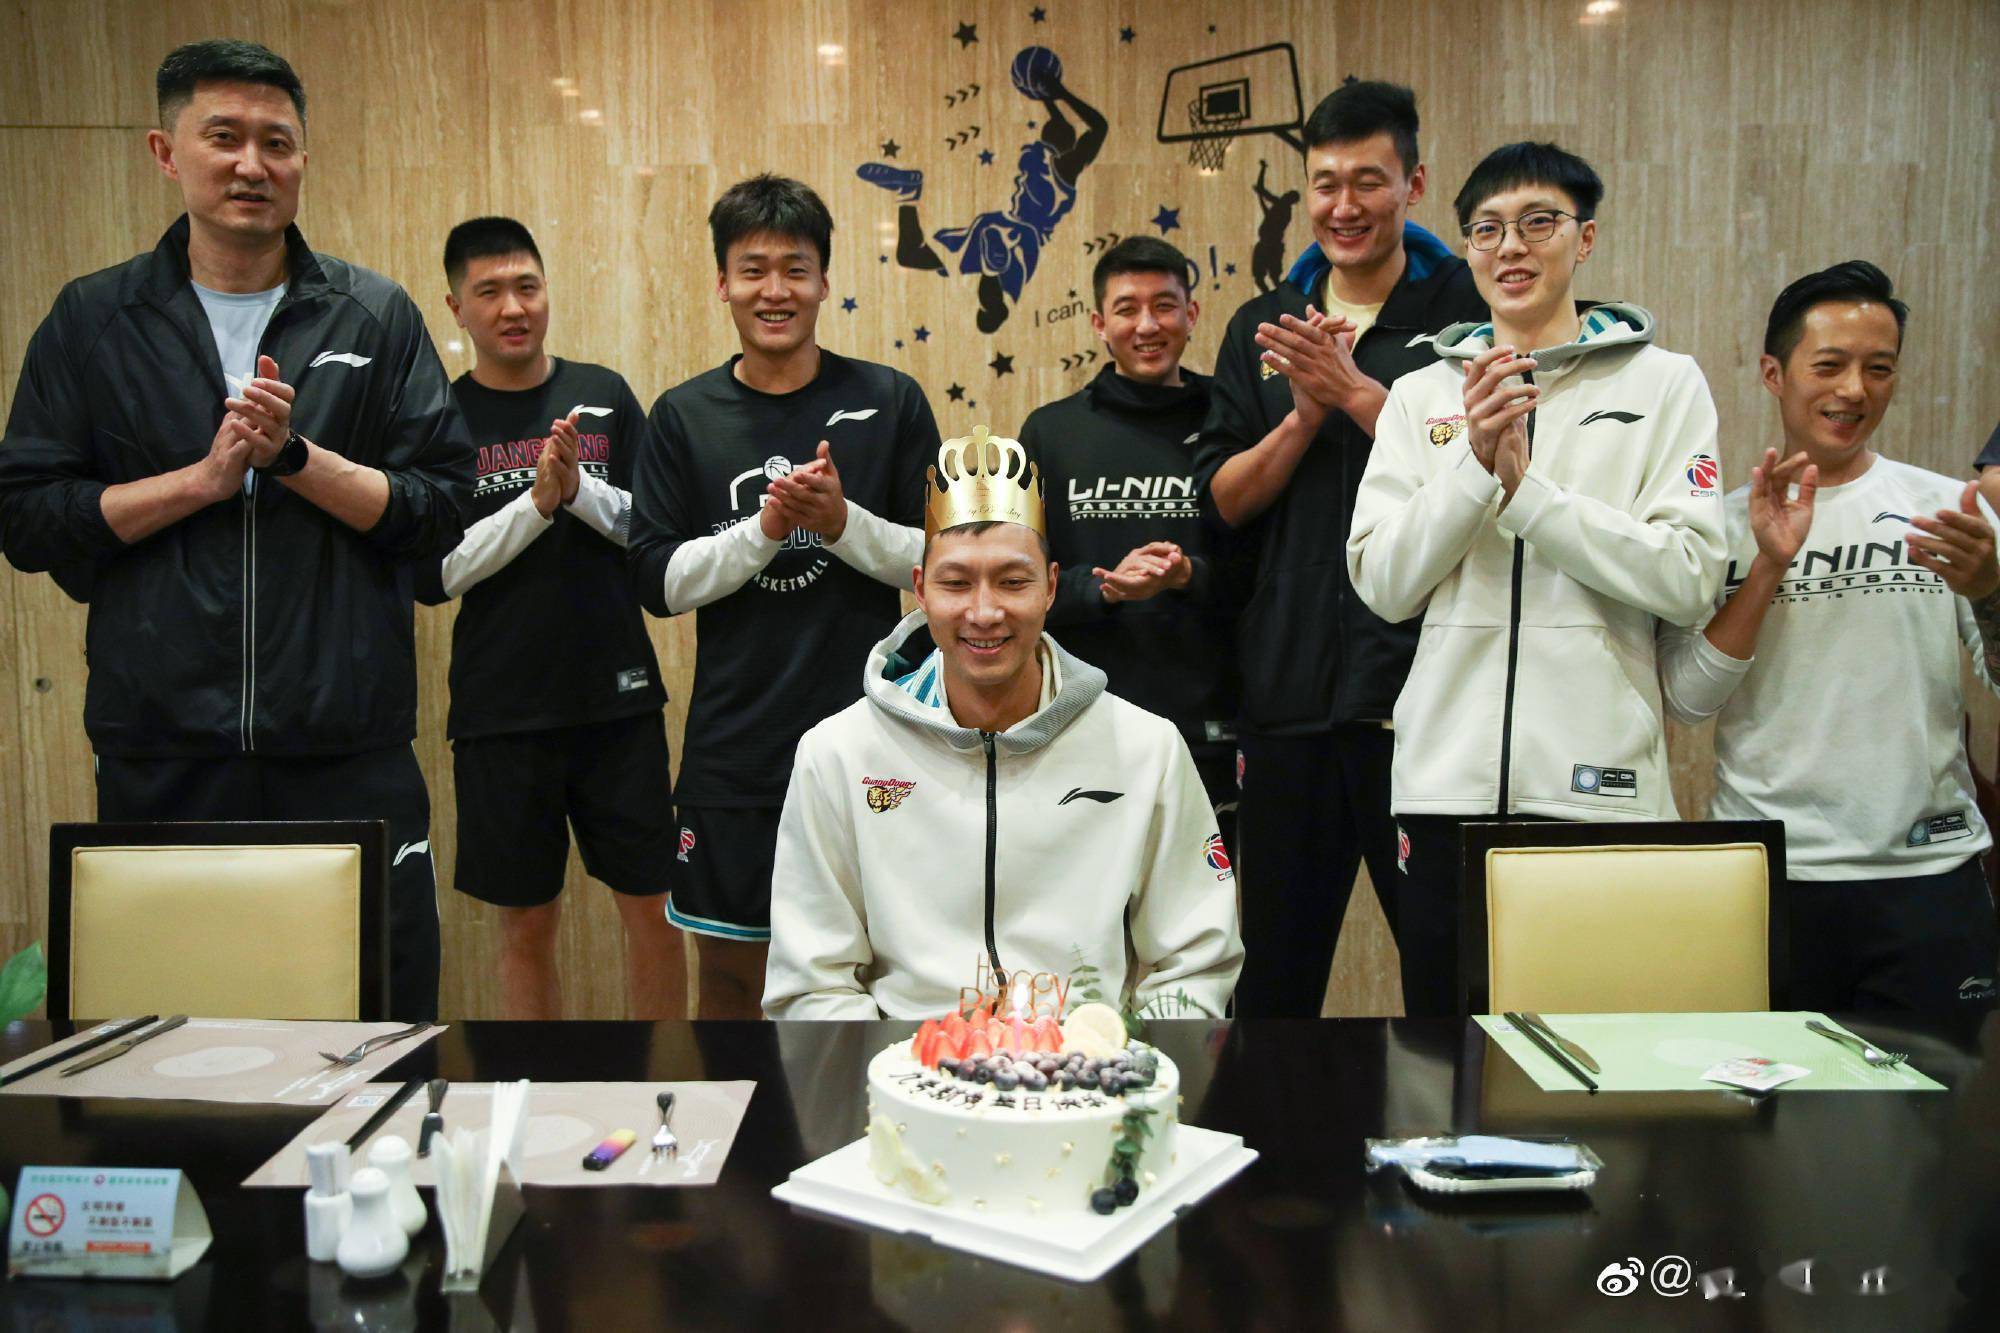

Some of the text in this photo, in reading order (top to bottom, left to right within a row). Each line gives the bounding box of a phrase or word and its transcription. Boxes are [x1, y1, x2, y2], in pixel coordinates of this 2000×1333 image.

[1034, 310, 1041, 327] I
[475, 434, 609, 476] UANGNG
[476, 464, 609, 489] ASKELL
[1068, 476, 1198, 501] LI-NIN
[1069, 502, 1194, 513] BASKETBA
[753, 559, 829, 592] ASKETBALL
[1725, 540, 1938, 587] L-NIN
[1725, 572, 1944, 600] SKETBALL
[1862, 586, 1944, 595] POSSIBLE
